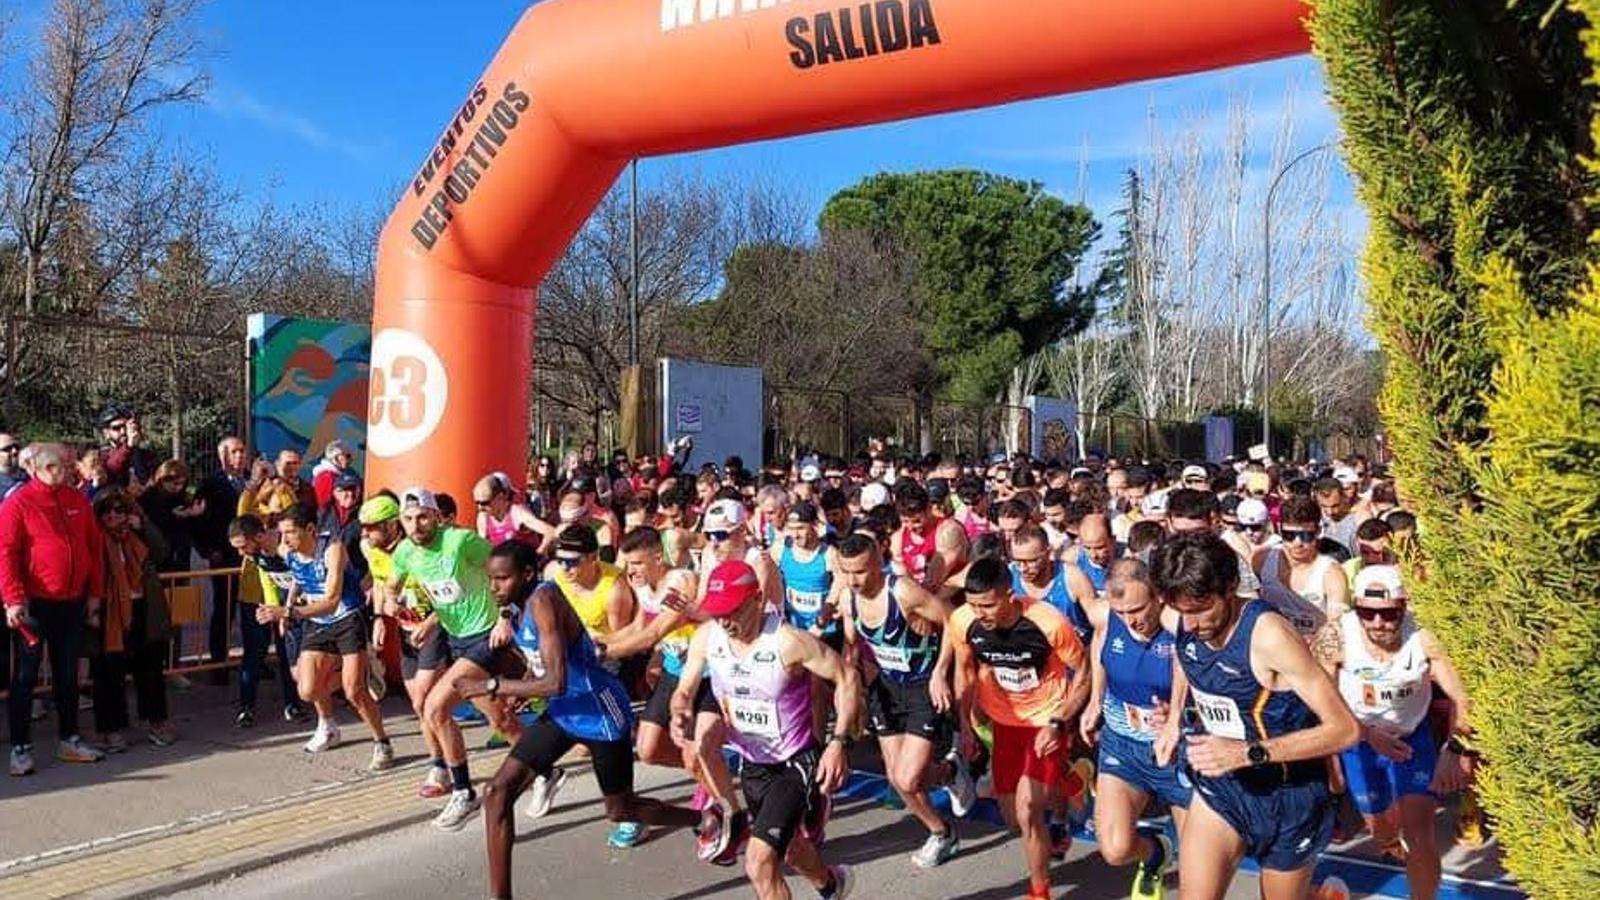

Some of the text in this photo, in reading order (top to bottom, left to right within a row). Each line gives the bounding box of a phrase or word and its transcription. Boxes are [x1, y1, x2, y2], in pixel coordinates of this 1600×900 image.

[785, 0, 941, 69] SALIDA
[410, 81, 530, 251] DEPORTIVOS
[413, 81, 488, 198] EVENTOS
[734, 708, 769, 726] M297
